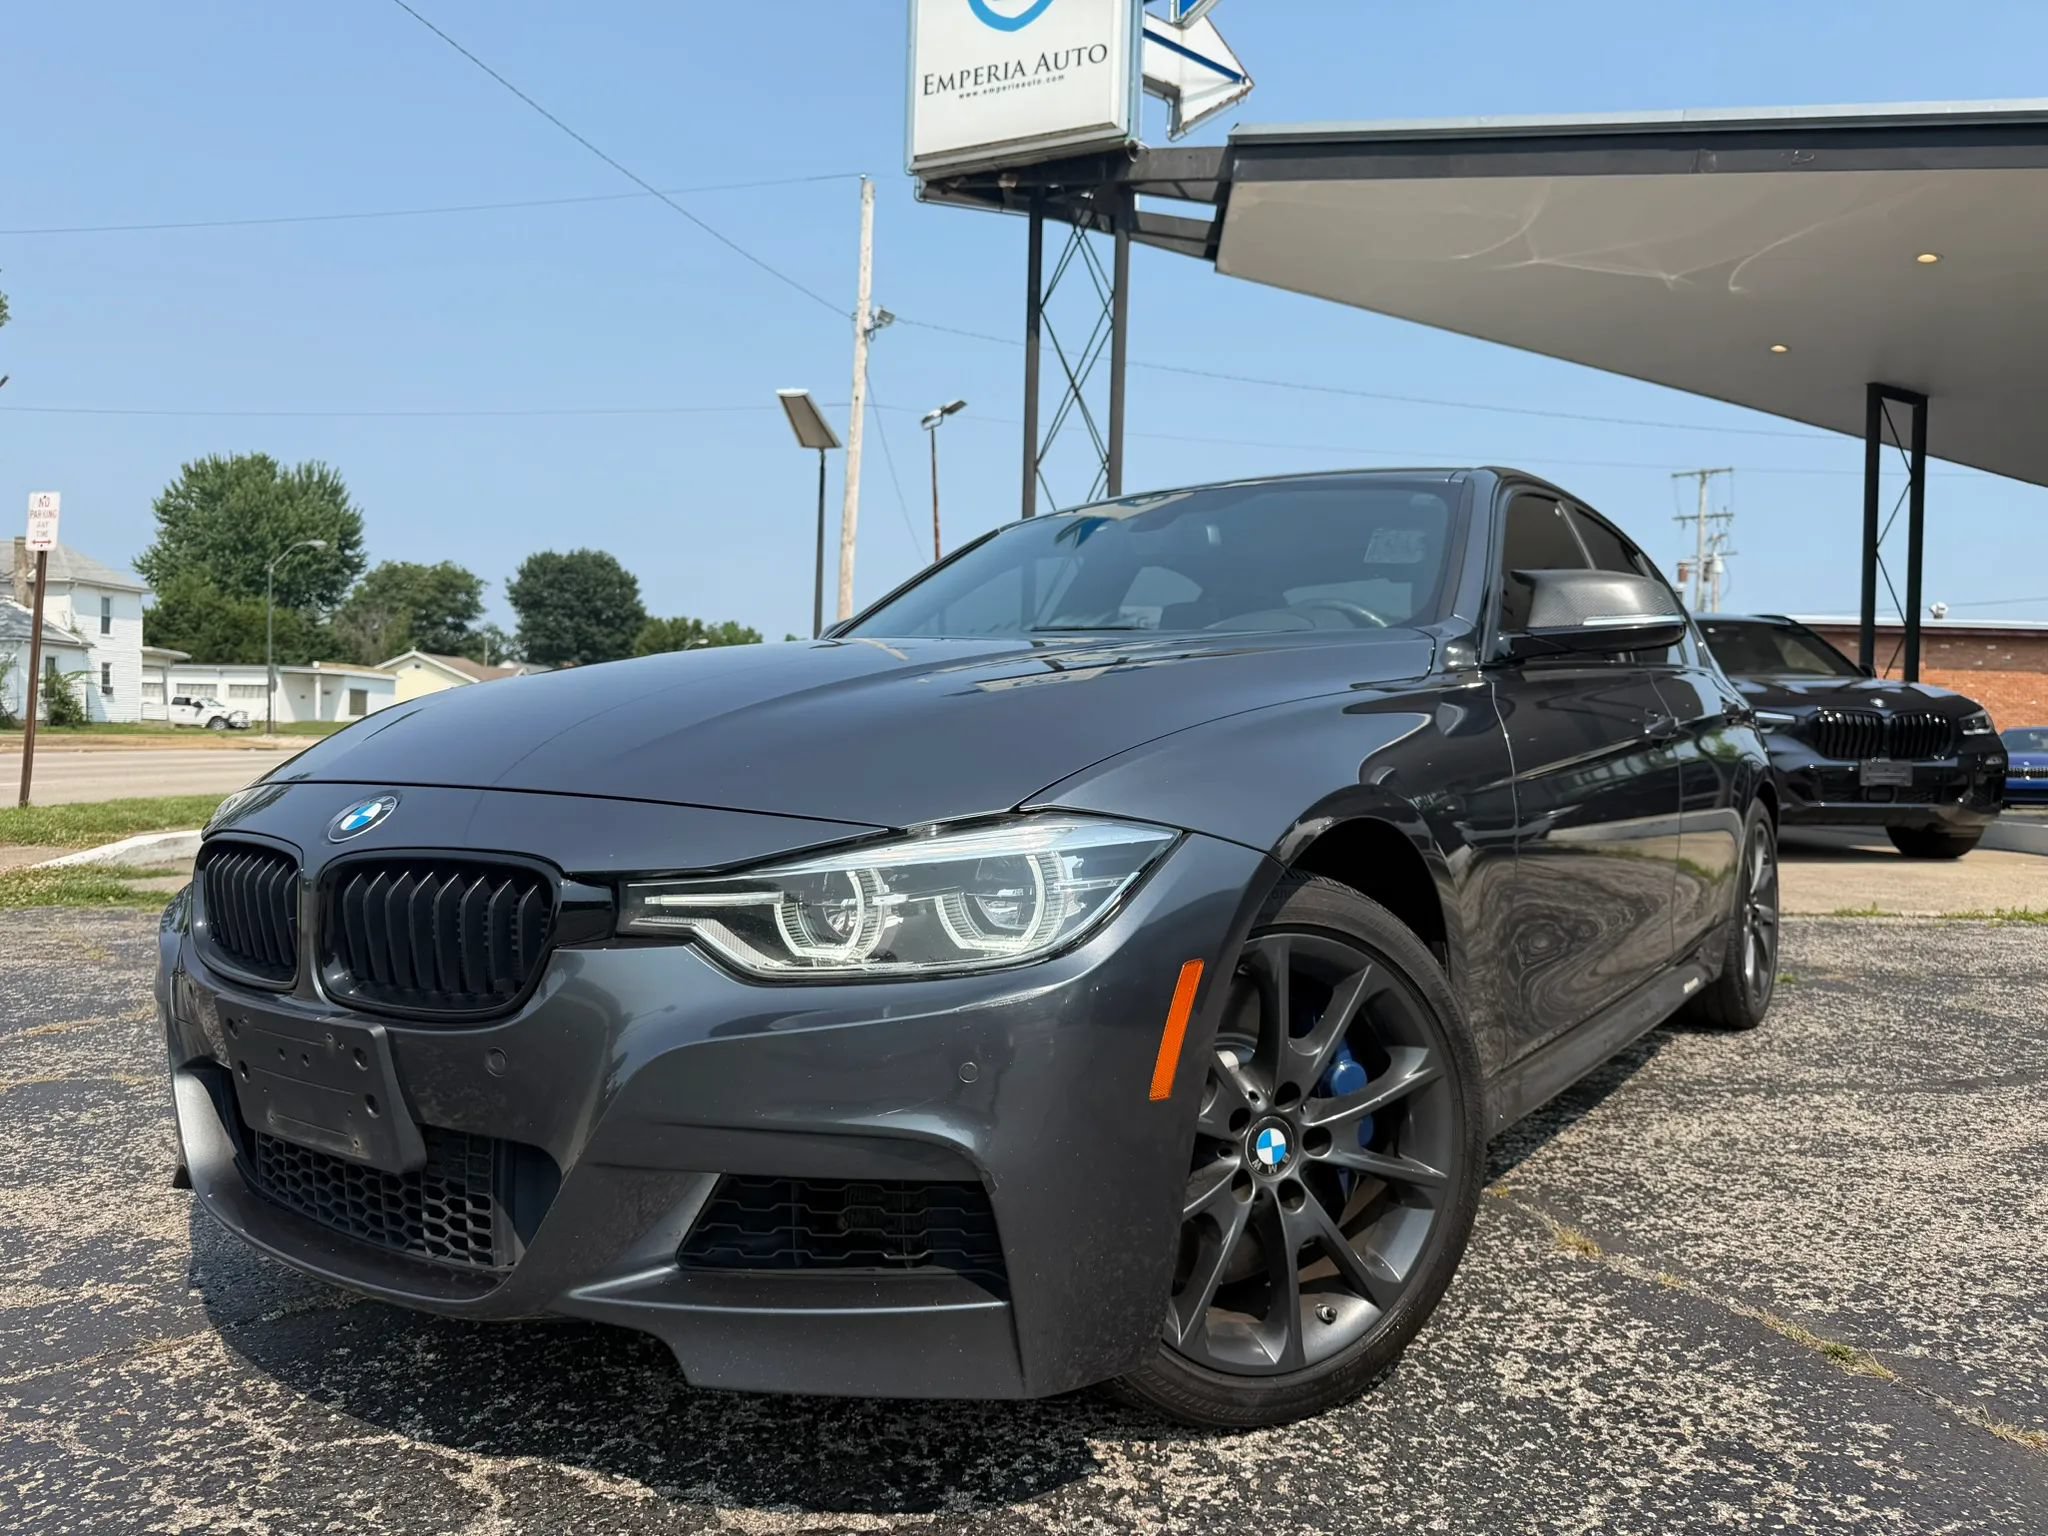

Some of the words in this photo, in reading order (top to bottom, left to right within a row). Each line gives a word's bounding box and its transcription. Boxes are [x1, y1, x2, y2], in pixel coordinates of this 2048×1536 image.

[923, 59, 1026, 96] EMPERIA
[1034, 43, 1108, 76] AUTO
[38, 497, 51, 508] NO
[30, 510, 57, 519] PARKING
